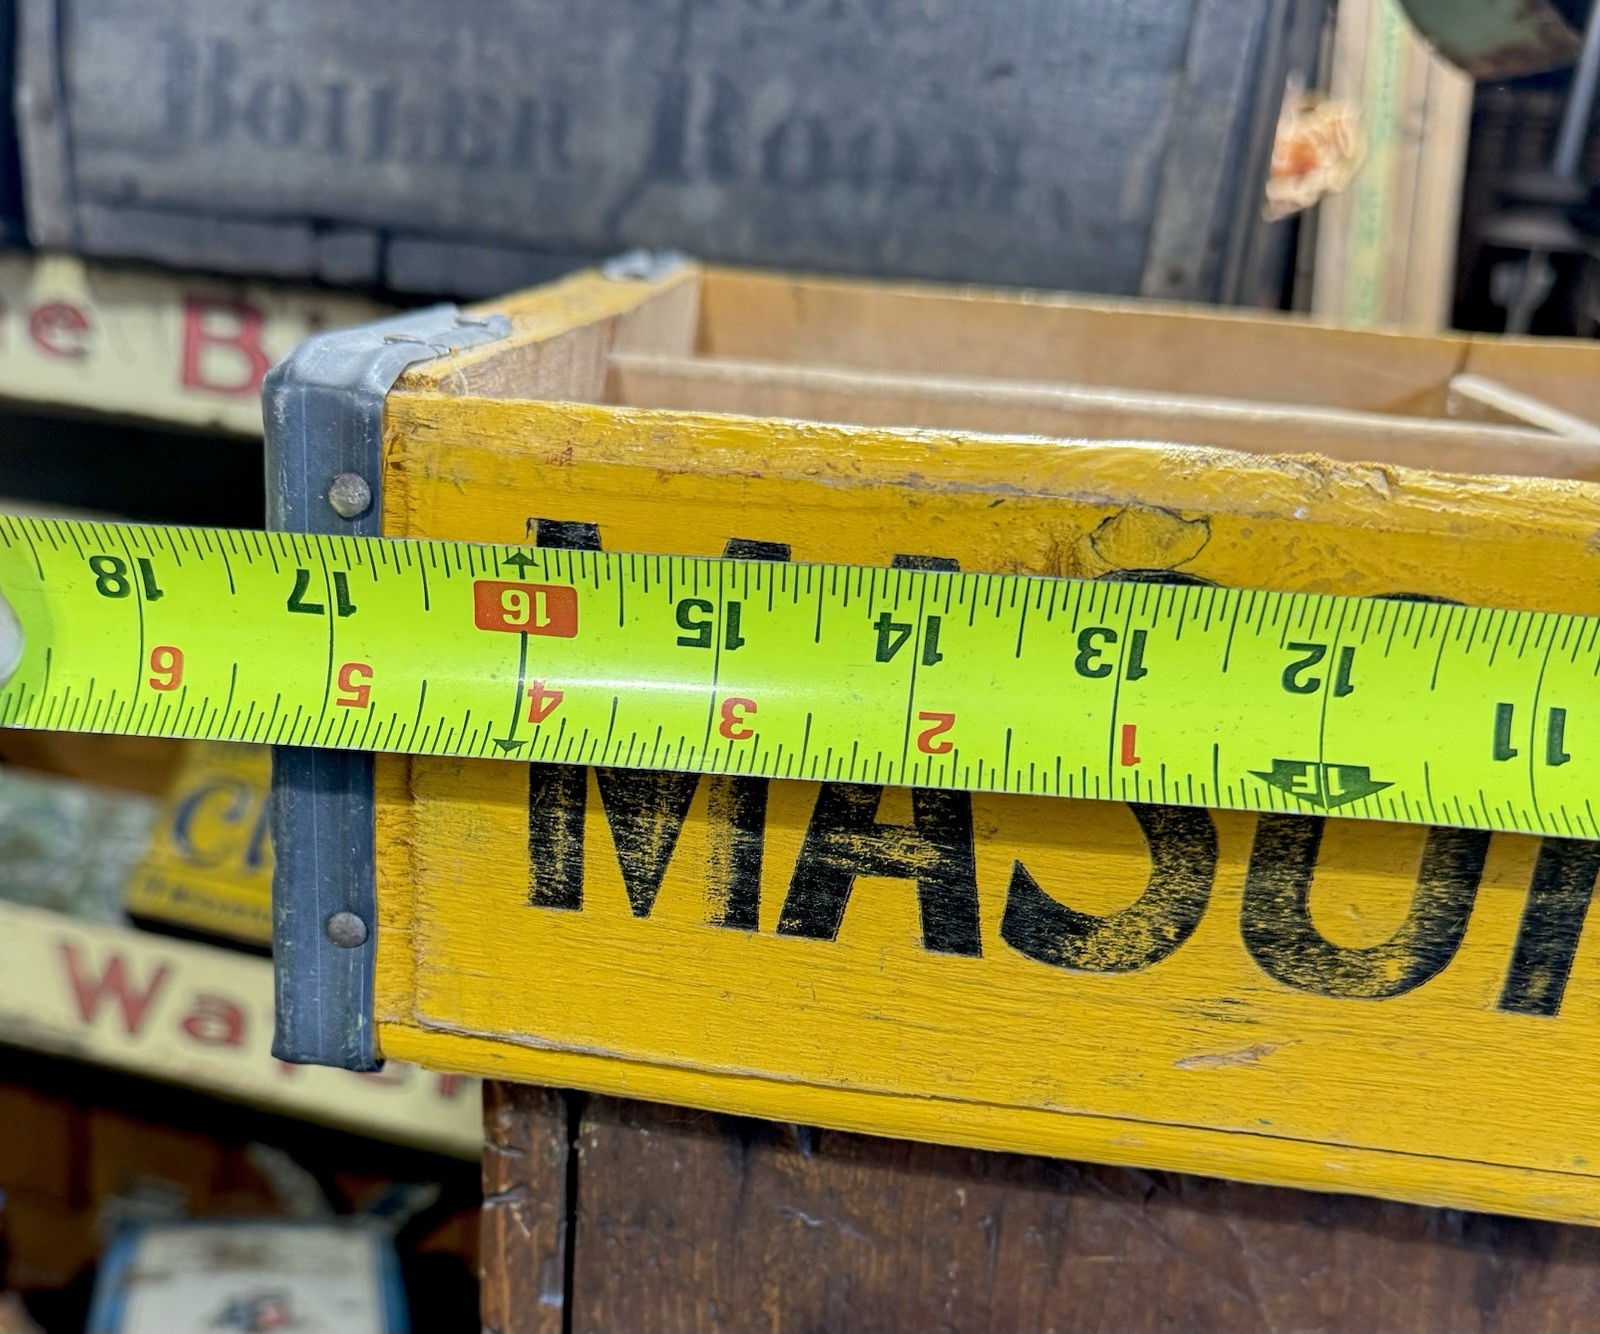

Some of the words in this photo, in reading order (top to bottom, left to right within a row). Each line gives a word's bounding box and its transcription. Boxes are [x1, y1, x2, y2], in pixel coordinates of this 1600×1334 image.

[88, 554, 165, 602] 18
[286, 568, 358, 618] 17
[499, 588, 551, 629] 16
[675, 597, 746, 652] 15
[873, 611, 944, 667] 14
[1075, 626, 1148, 681] 13
[149, 644, 185, 692] 6
[336, 662, 375, 709] 5
[1282, 641, 1356, 698] 12
[527, 680, 564, 724] 4
[718, 696, 758, 741] 3
[917, 711, 956, 755] 2
[1120, 723, 1142, 768] 1
[1492, 702, 1571, 767] 11
